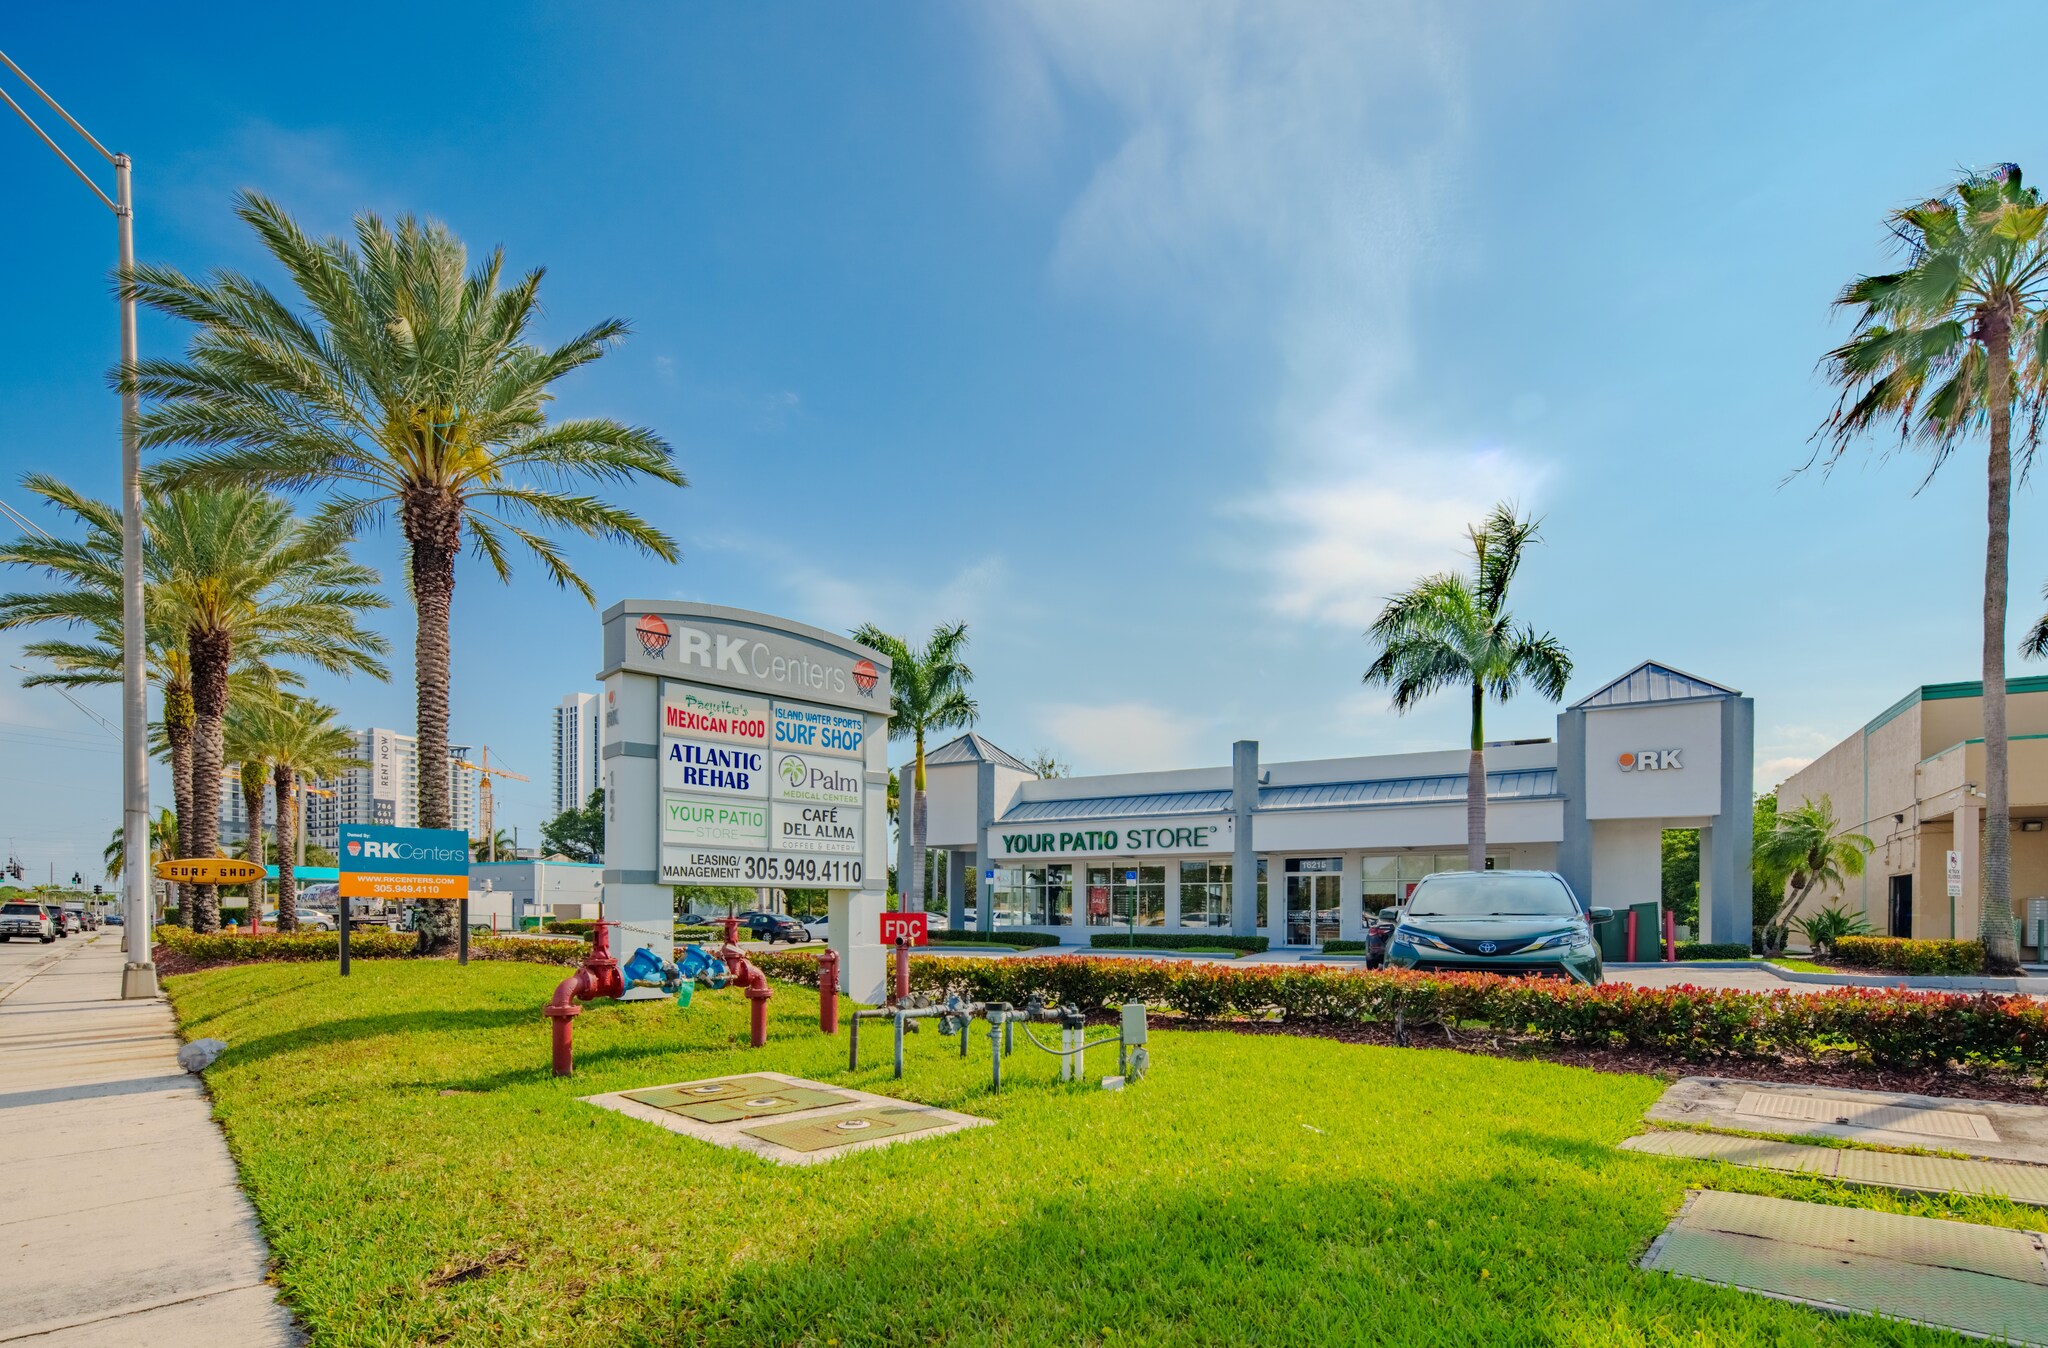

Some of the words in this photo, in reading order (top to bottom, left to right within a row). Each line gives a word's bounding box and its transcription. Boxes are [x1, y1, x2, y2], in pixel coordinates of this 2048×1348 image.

[667, 706, 728, 734] MEXICAN
[731, 720, 765, 739] FOOD
[775, 707, 804, 722] ISLAND
[805, 712, 832, 726] WATER
[833, 716, 863, 731] SPORTS
[775, 720, 817, 746] SURF
[821, 727, 863, 752] SHOP
[381, 736, 389, 760] NOW
[669, 743, 762, 772] ATLANTIC
[1637, 749, 1684, 771] RK
[381, 763, 389, 787] RENT
[683, 766, 750, 790] REHAB
[810, 767, 858, 793] Palm
[783, 790, 821, 800] MEDICAL
[822, 793, 859, 804] CENTERS
[669, 805, 715, 824] YOUR
[719, 809, 764, 827] PATIO
[802, 807, 838, 823] CAFÉ
[696, 827, 739, 839] STORE
[783, 822, 811, 836] DEL
[815, 825, 855, 840] ALMA
[1002, 833, 1056, 854] YOUR
[1059, 830, 1119, 852] PATIO
[1126, 826, 1209, 850] STORE
[782, 841, 815, 850] COFFEE
[826, 844, 857, 852] EATERY
[690, 854, 742, 867] LEASING/
[744, 856, 862, 883] 305.949.4110
[1302, 861, 1327, 869] 16215
[171, 867, 208, 877] SURF
[220, 868, 256, 877] SHOP
[357, 875, 455, 885] WWW.RKCENTERS.COM
[663, 866, 740, 879] MANAGEMENT
[373, 884, 440, 894] 305.949.4110
[885, 920, 921, 938] FDC
